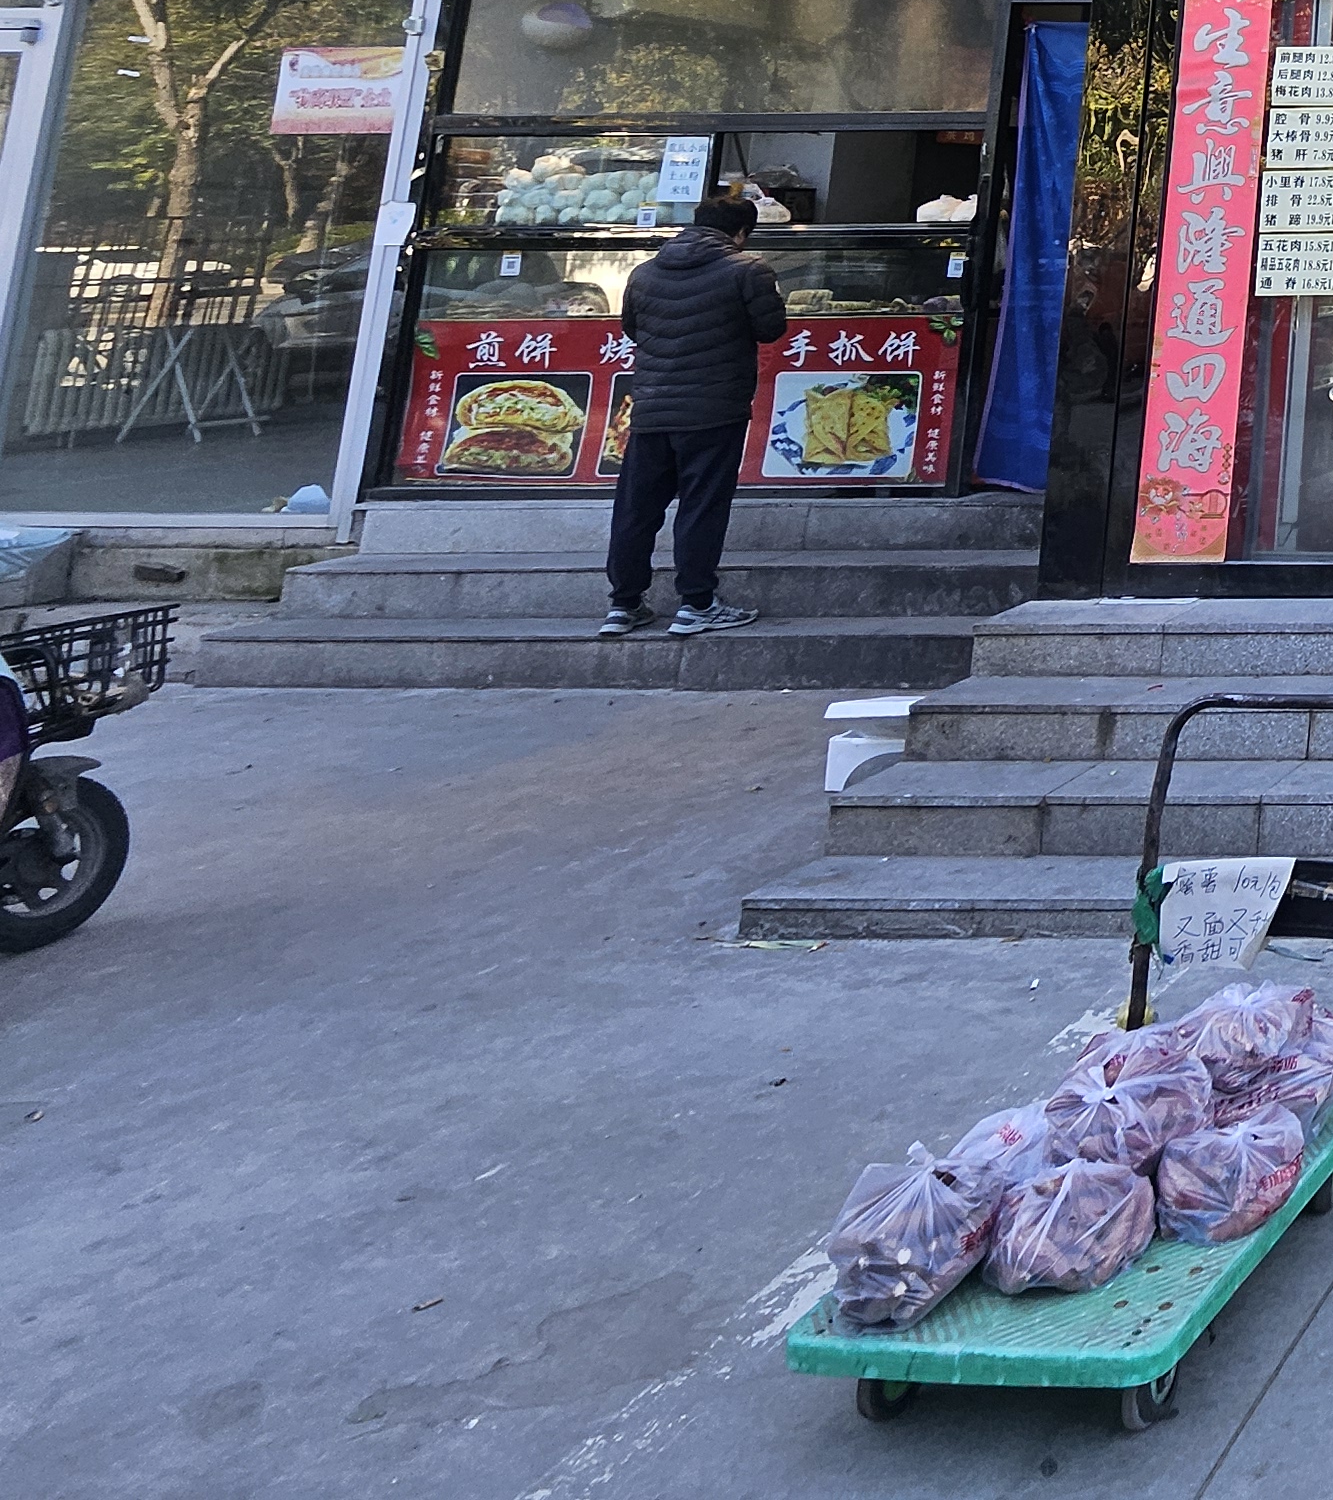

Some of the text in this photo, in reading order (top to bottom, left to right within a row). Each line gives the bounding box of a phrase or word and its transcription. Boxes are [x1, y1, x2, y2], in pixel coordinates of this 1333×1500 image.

[466, 330, 557, 369] 煎饼
[782, 329, 921, 368] 手抓饼
[1156, 6, 1253, 474] 生意興隆通四海
